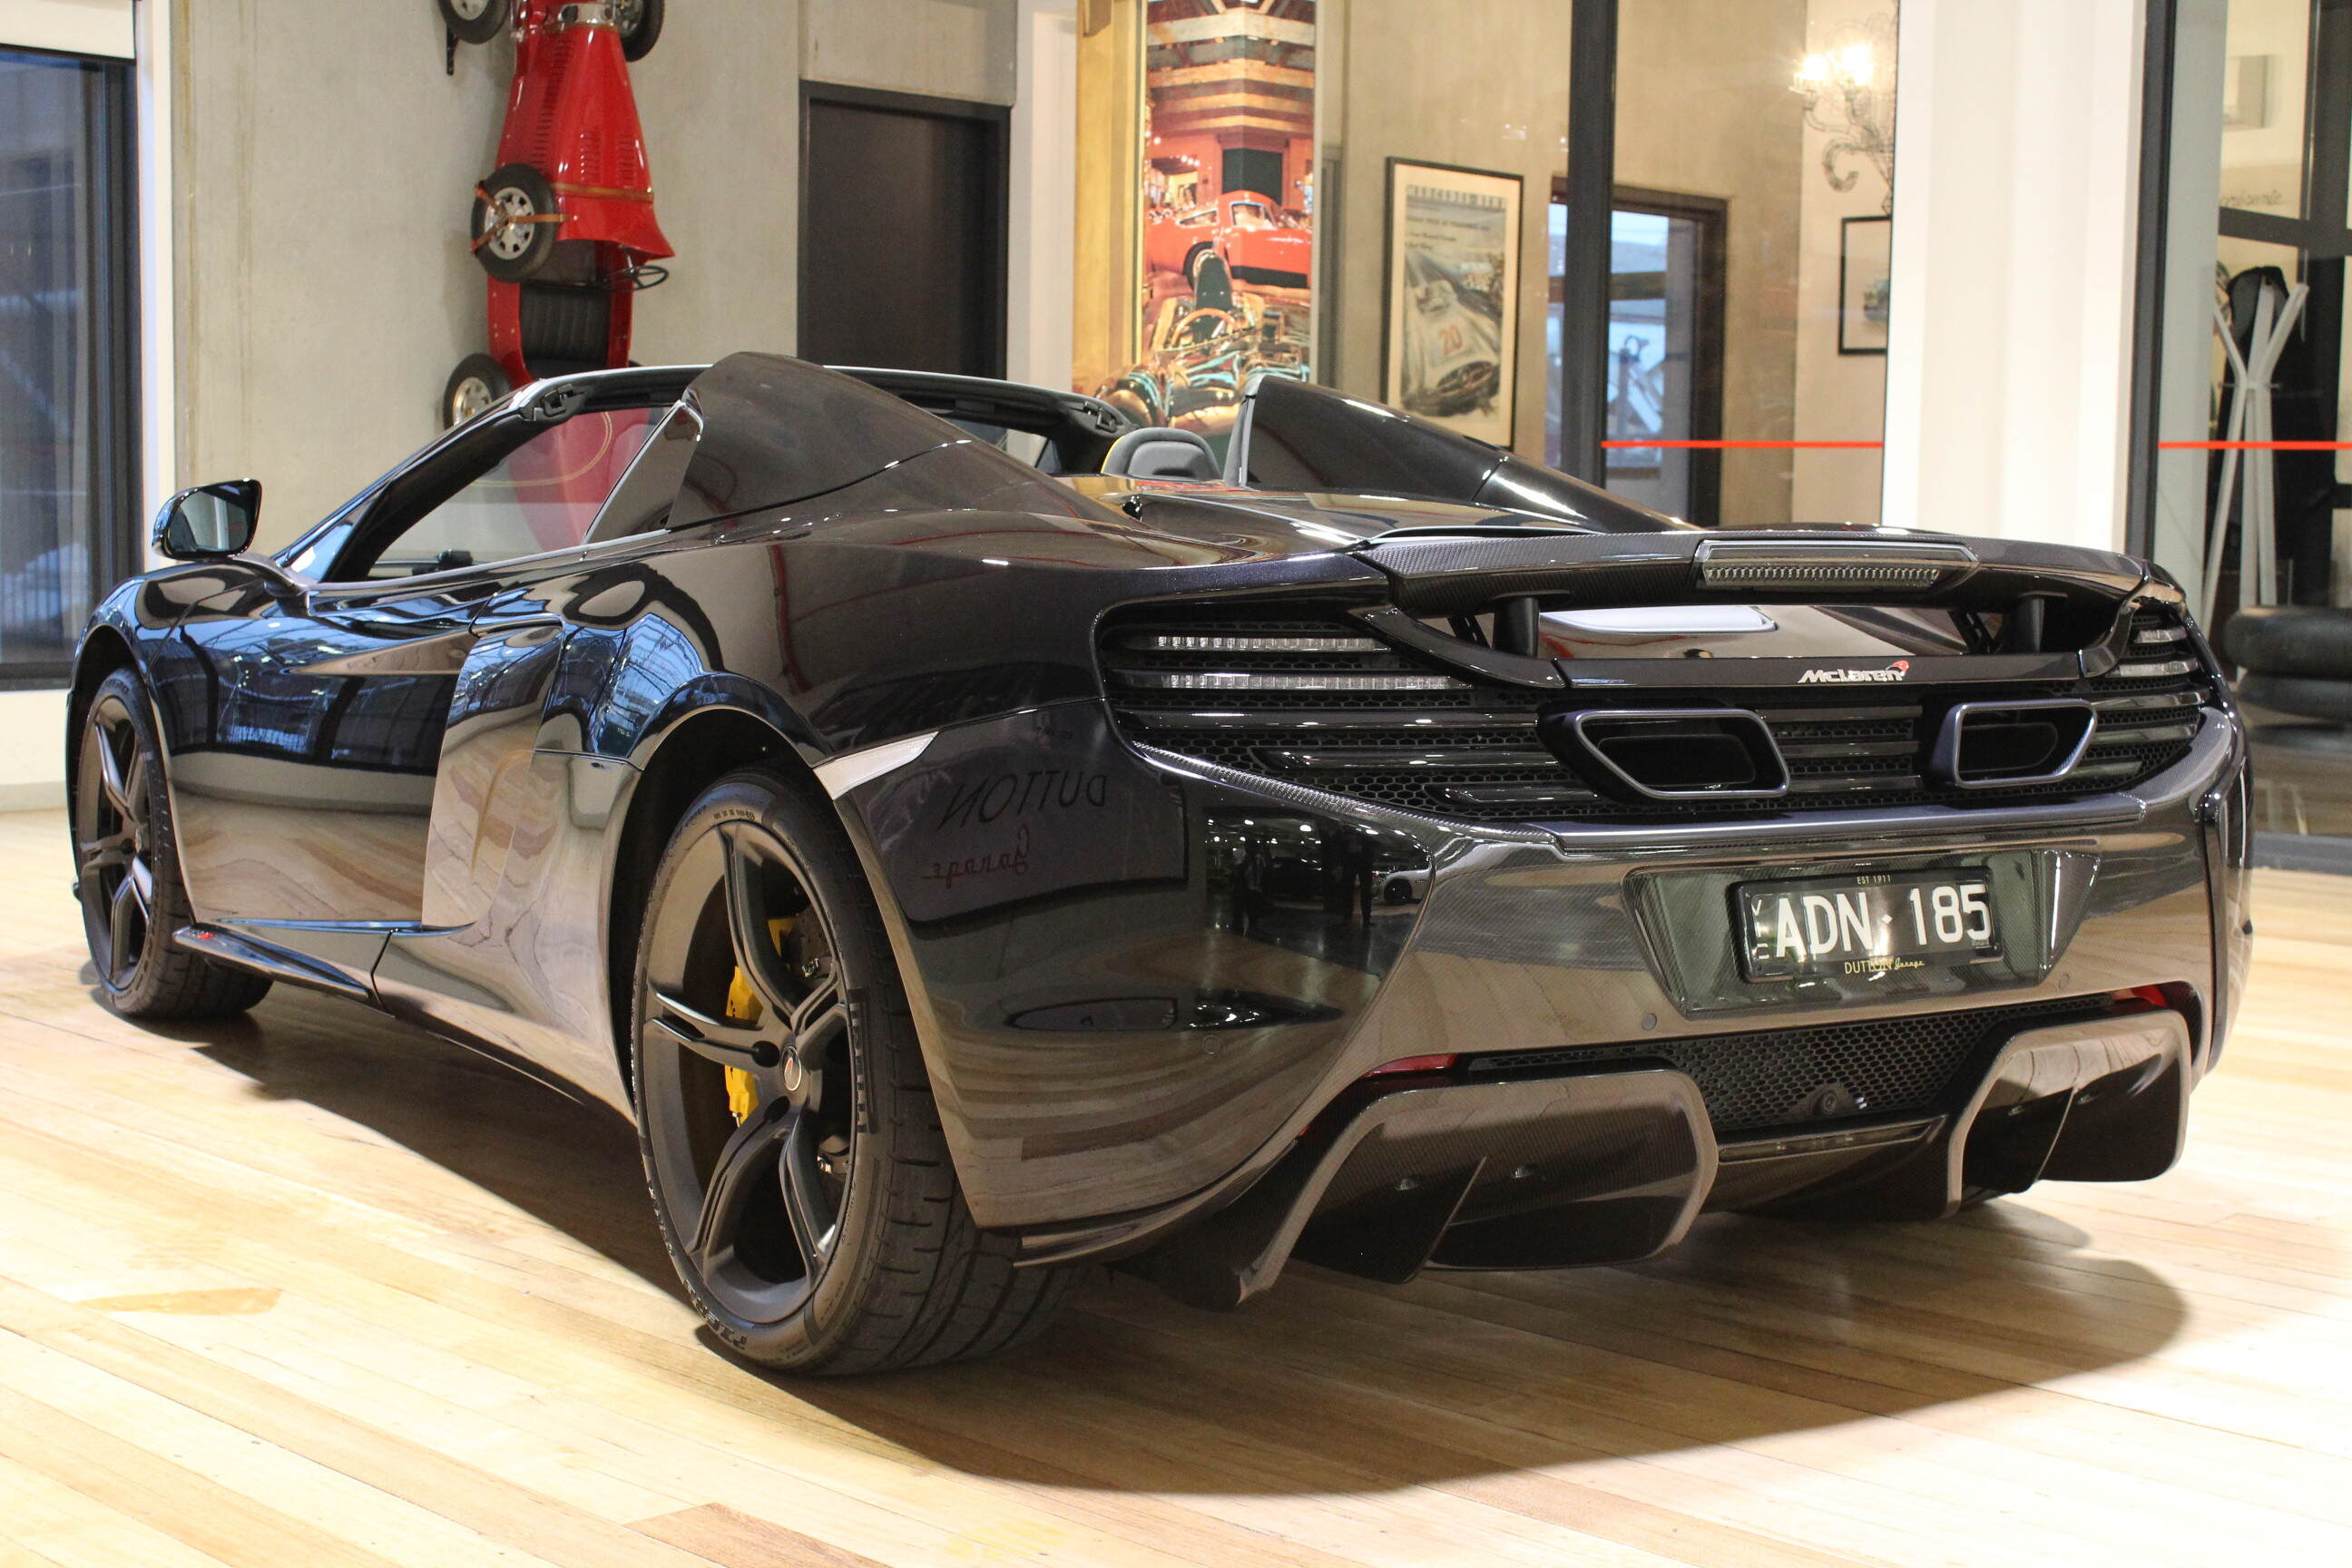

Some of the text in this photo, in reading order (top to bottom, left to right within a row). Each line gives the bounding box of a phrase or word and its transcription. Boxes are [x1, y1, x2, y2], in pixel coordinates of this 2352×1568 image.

[1437, 324, 1464, 356] 20
[1798, 667, 1905, 683] McLaren
[1857, 874, 1892, 886] EST 1911
[1776, 884, 1992, 958] ADN 185
